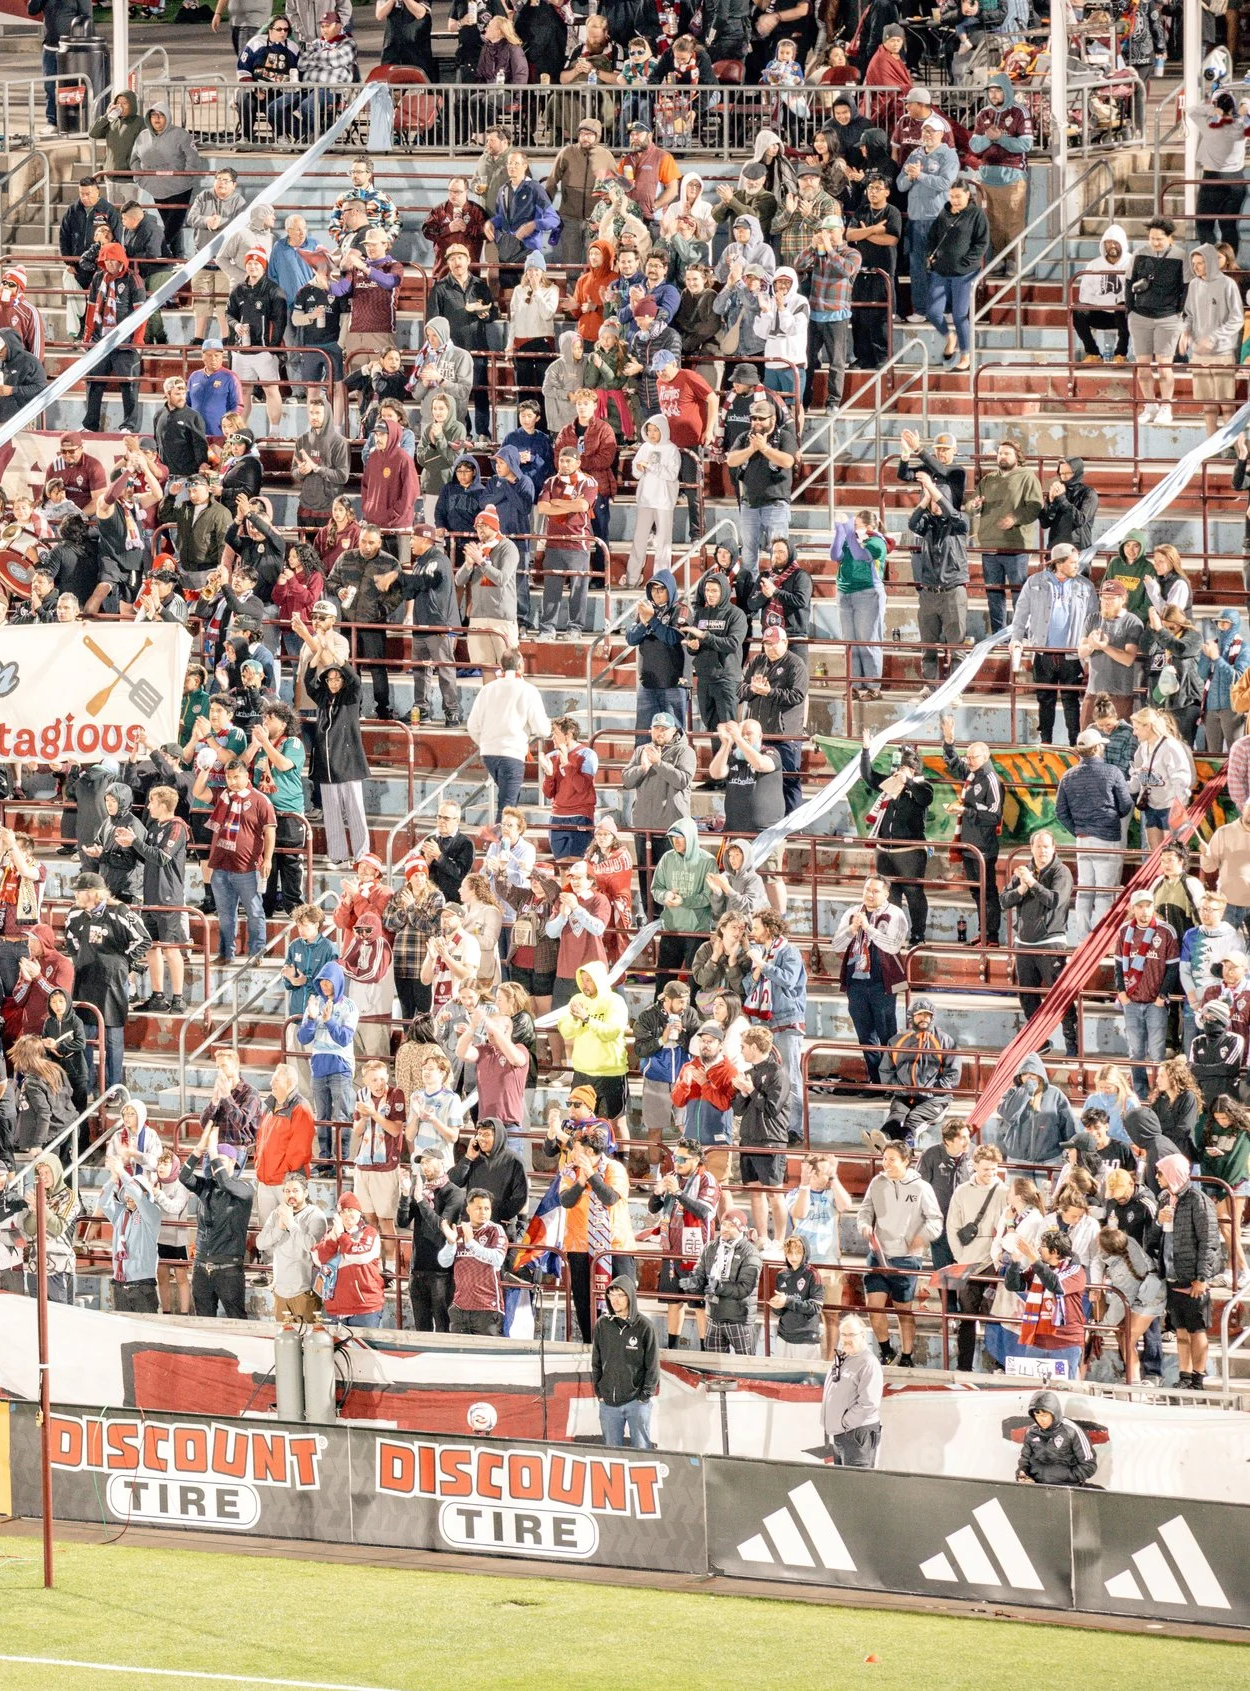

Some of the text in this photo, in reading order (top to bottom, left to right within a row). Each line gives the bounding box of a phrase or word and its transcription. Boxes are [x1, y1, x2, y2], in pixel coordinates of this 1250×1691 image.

[50, 1417, 318, 1488] DISCOUNT
[379, 1442, 659, 1516] DISCOUNT
[123, 1480, 241, 1520] TIRE
[456, 1508, 579, 1550] TIRE
